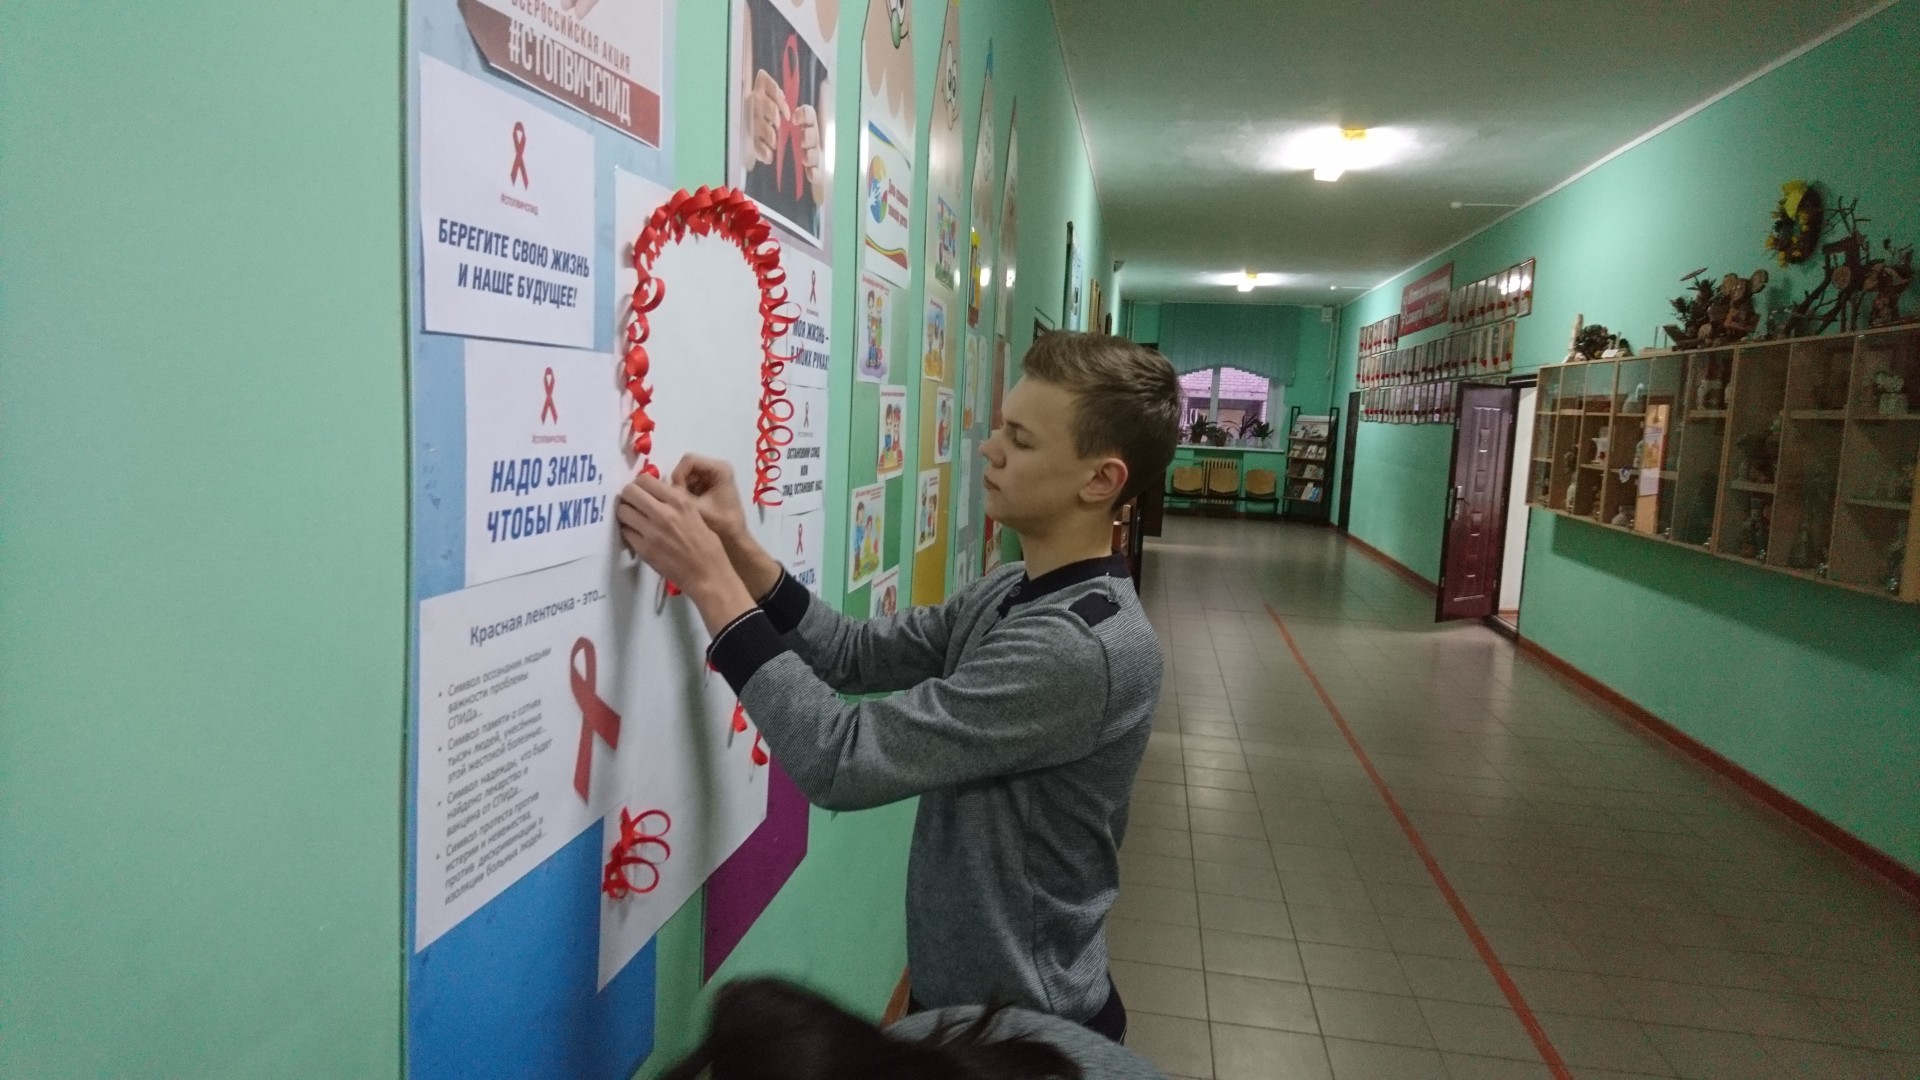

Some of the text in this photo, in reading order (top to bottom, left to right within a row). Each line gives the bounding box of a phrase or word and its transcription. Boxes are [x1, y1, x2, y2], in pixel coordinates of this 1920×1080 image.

[508, 18, 632, 127] #СТОПВИЧСПИД
[602, 41, 631, 74] АКЦИЯ
[438, 217, 590, 278] БЕРЕГИТЕ СВОЮ ЖИЗНЬ
[458, 262, 578, 309] И НАШЕ БУДУЩЕЕ!
[490, 454, 603, 497] НАДО ЗНАТЬ,
[487, 494, 607, 543] ЧТОБЫ ЖИТЬ!
[470, 615, 523, 647] Красная
[525, 597, 575, 626] ленточка
[582, 589, 606, 606] это...
[448, 676, 480, 697] Символ
